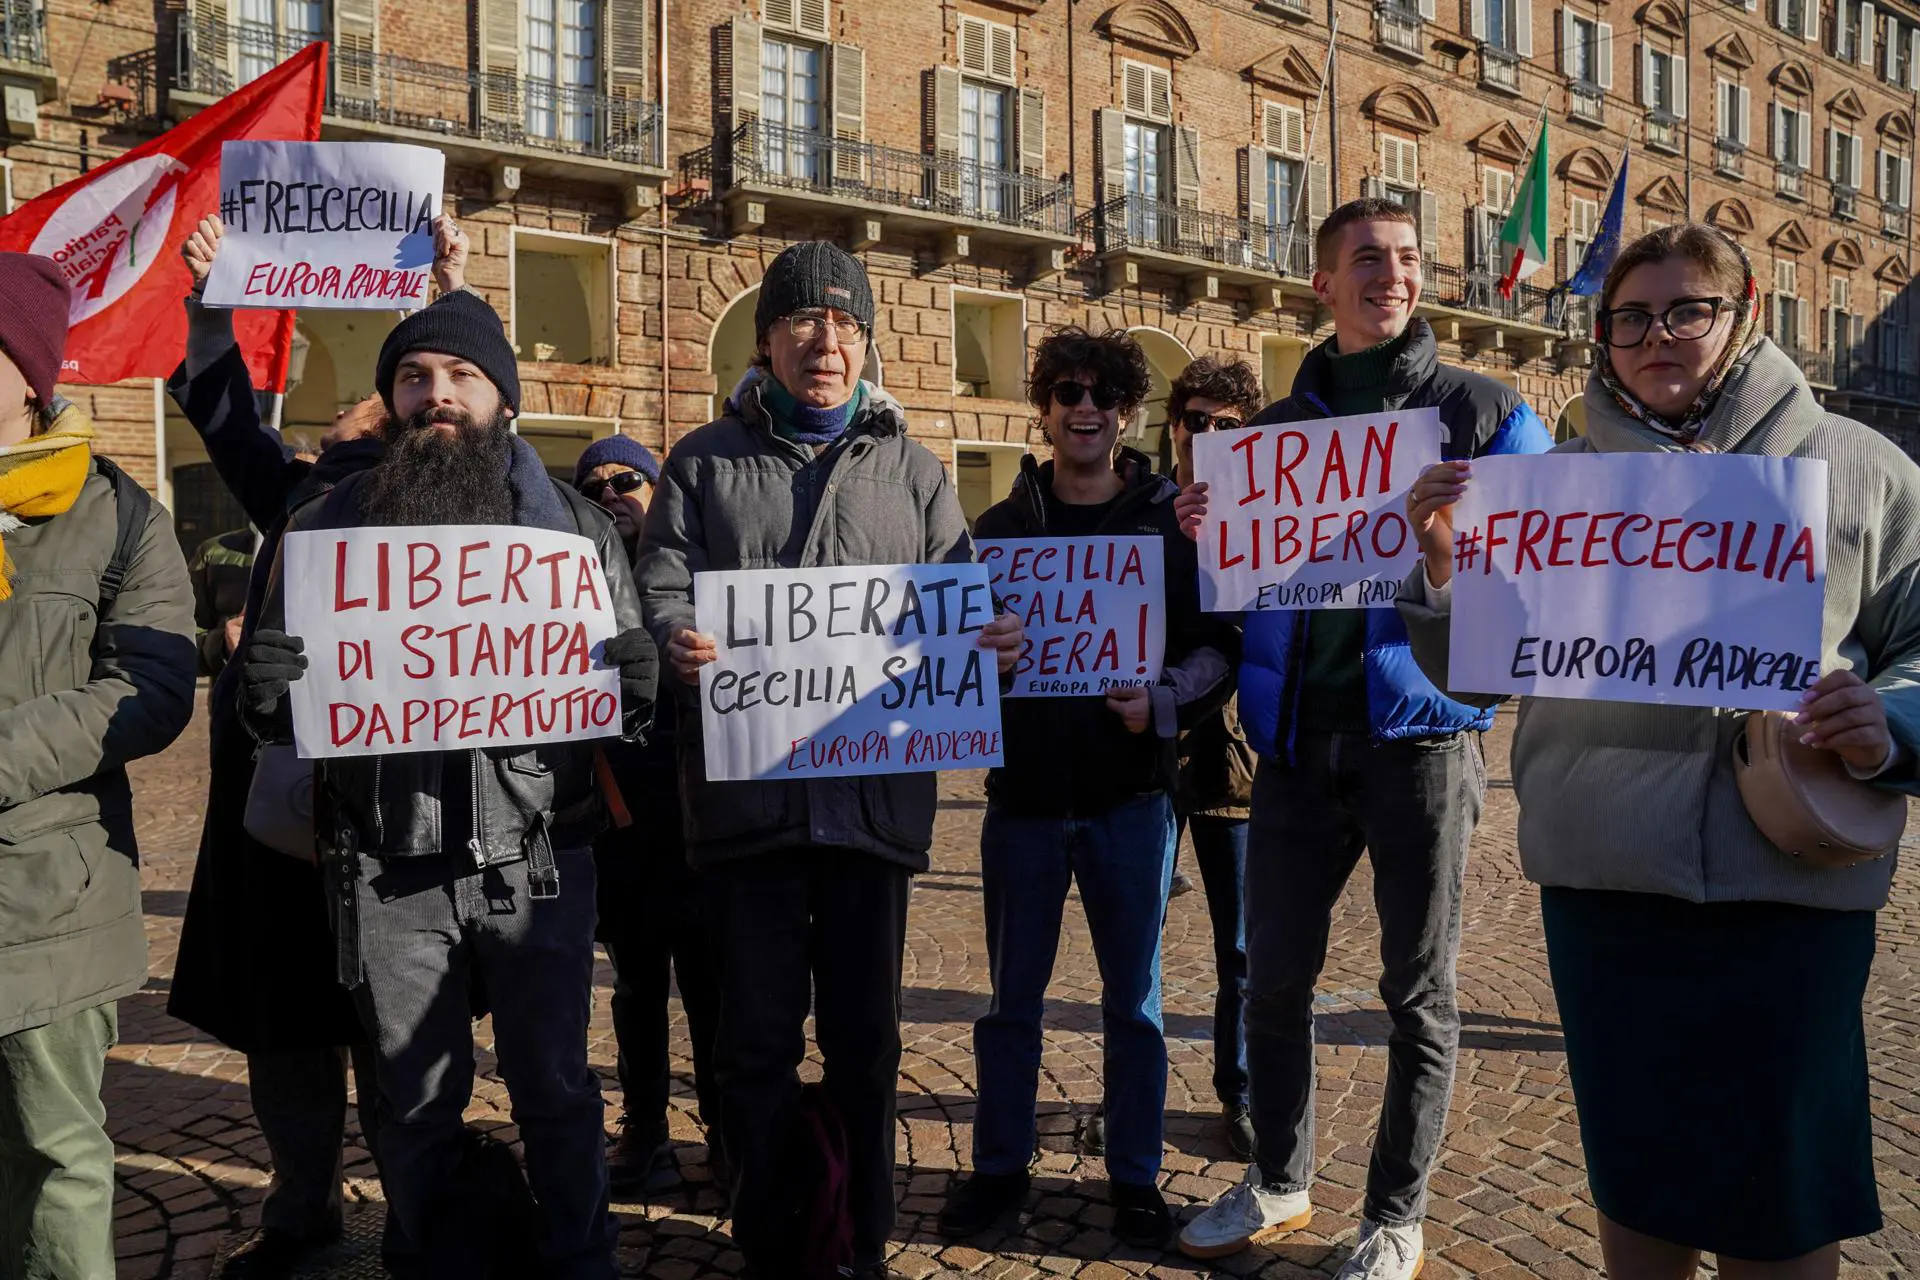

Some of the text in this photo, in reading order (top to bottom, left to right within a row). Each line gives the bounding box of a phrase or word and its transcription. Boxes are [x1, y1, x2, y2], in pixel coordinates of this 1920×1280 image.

[220, 179, 433, 236] #FREECECILIA
[245, 261, 428, 300] EUROPA RADICALE
[1231, 422, 1398, 507] IRAN
[978, 542, 1146, 585] CECILIA
[1219, 509, 1424, 570] LIBERO
[1454, 509, 1815, 583] #FREECECILIA
[726, 577, 985, 649] LIBERATE
[1003, 589, 1097, 627] SALA
[1255, 581, 1344, 610] EUROPA
[338, 621, 590, 680] DI STAMPA
[1511, 636, 1820, 691] EUROPA RADICALE
[709, 649, 984, 714] CECILIA SALA
[1028, 679, 1089, 694] EUROPA
[329, 687, 617, 748] DAPPERTUTTO
[787, 729, 1000, 771] EUROPA RADICALE
